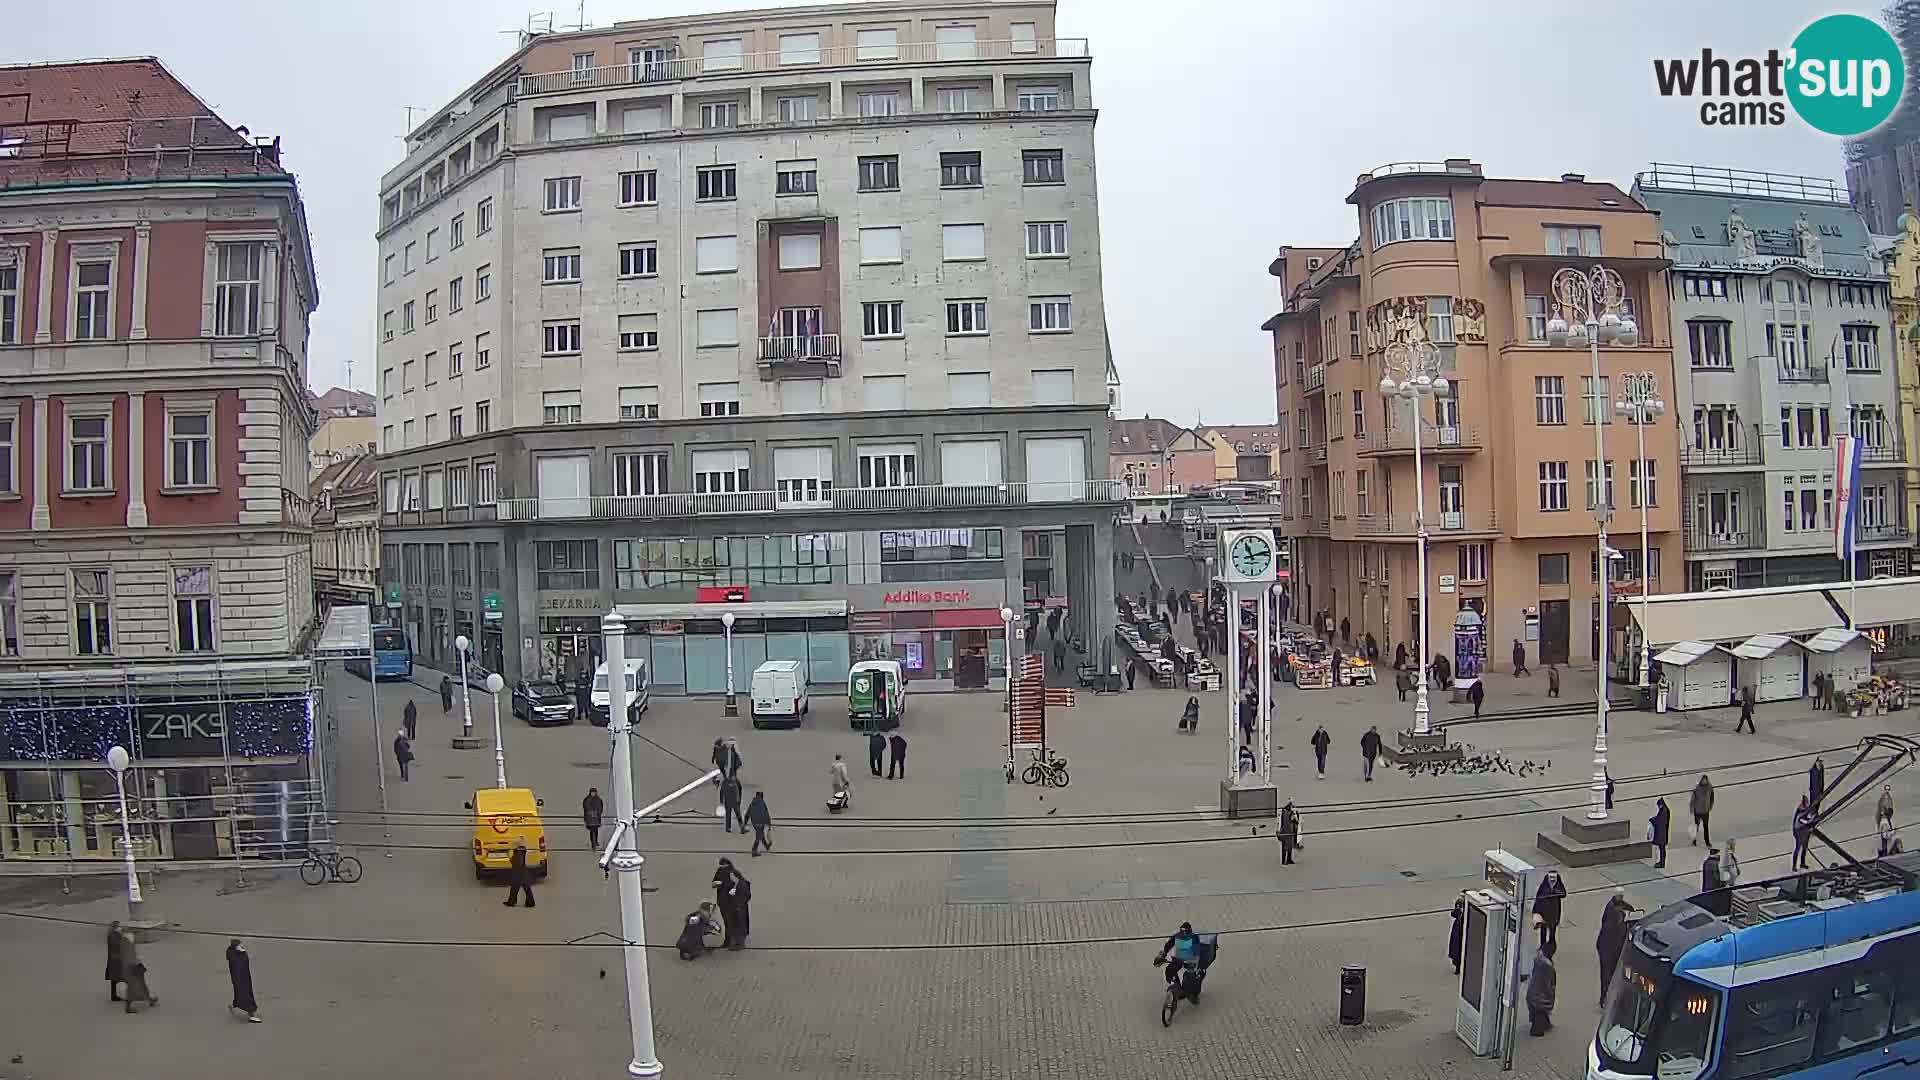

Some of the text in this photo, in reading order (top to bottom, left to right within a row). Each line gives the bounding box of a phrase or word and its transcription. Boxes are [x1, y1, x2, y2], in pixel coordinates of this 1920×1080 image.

[884, 588, 970, 604] Addiko Bank
[143, 713, 225, 738] ZAKS
